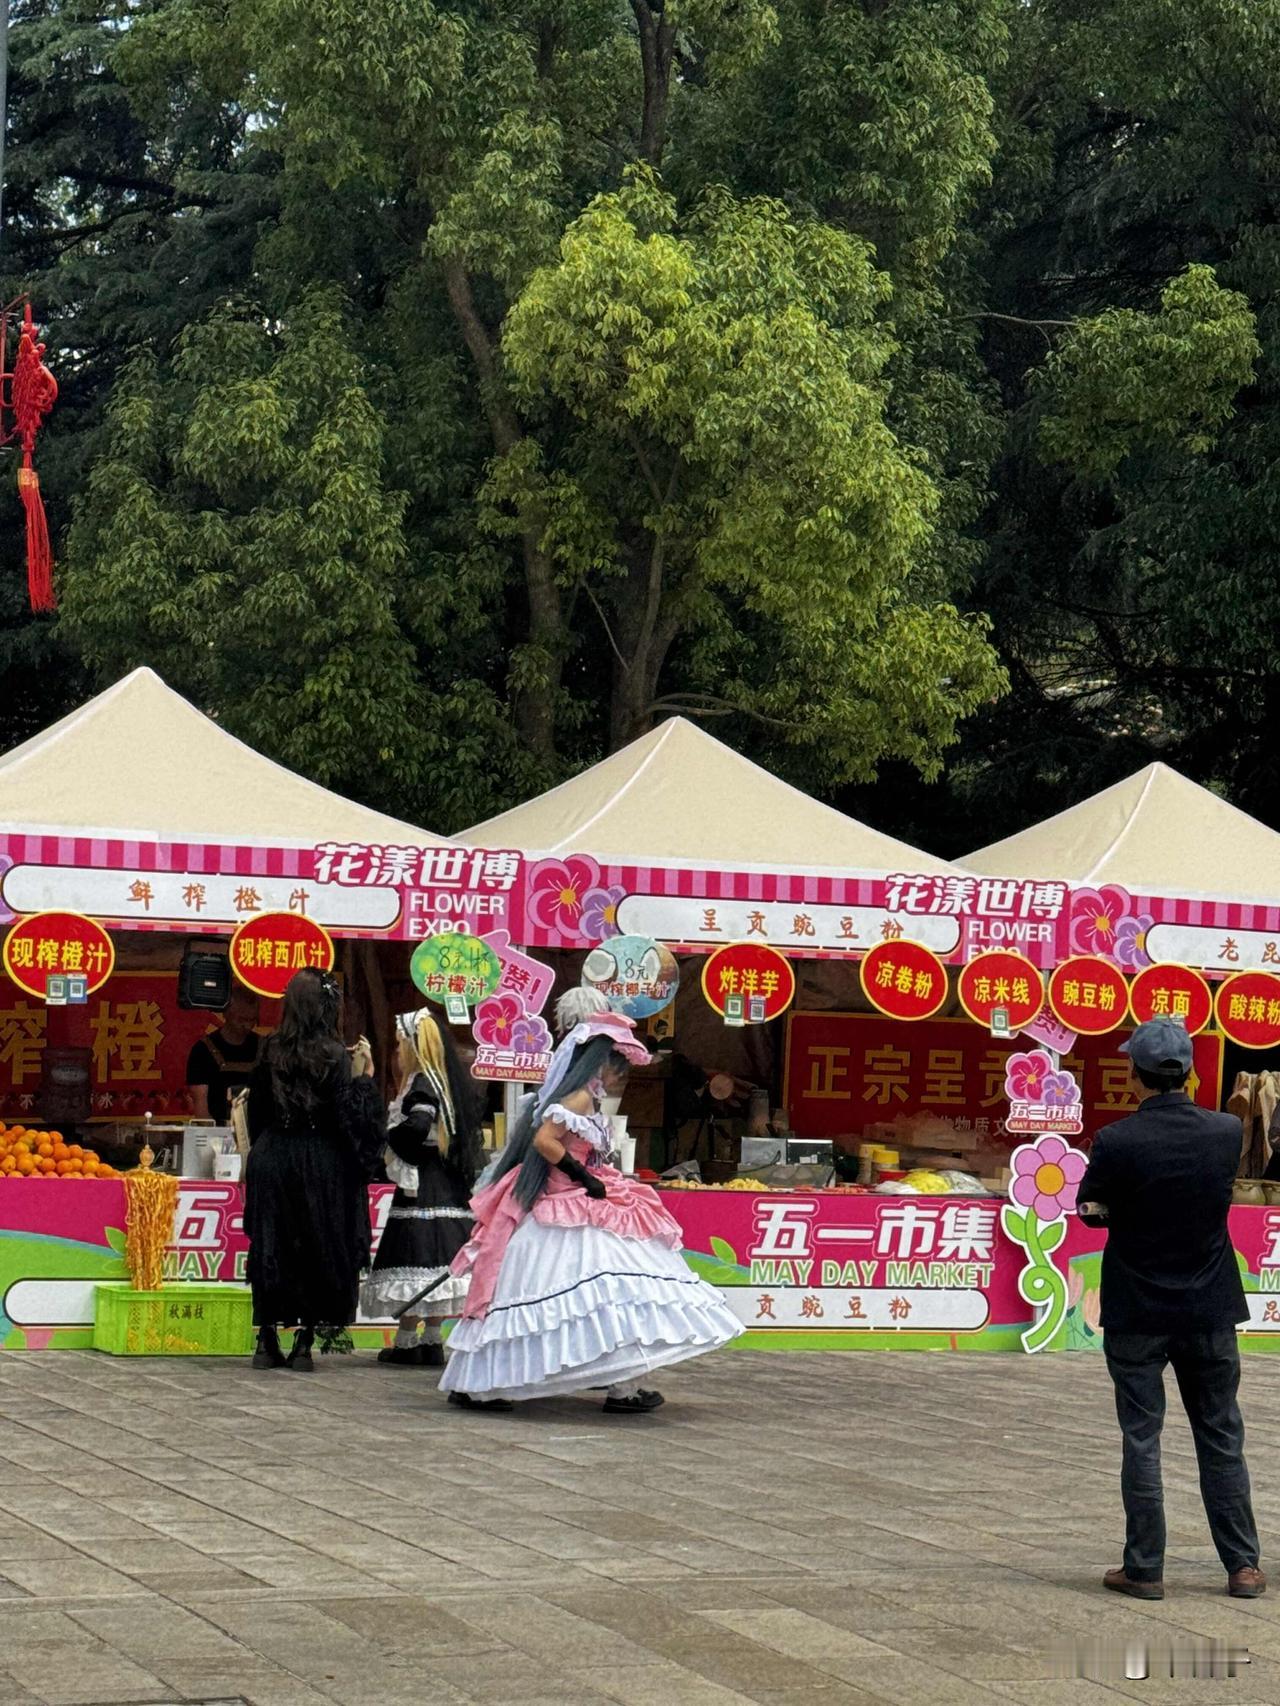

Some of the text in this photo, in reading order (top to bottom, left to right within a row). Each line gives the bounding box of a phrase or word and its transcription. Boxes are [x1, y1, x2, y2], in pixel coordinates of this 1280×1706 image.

[314, 845, 520, 891] 花漾世博
[126, 878, 310, 915] 鲜榨橙汁
[409, 892, 505, 915] FLOWER
[886, 877, 1065, 919] 花漾世博
[699, 907, 905, 940] 呈贡豌豆粉
[968, 920, 1052, 943] FLOWER
[11, 937, 108, 973] 现榨橙汁
[238, 937, 326, 968] 现榨西瓜汁
[624, 958, 649, 980] 8元
[719, 966, 780, 999] 炸洋芋
[875, 960, 933, 1000] 凉卷粉
[426, 972, 488, 997] 柠檬汁
[973, 977, 1031, 1006] 凉米线
[1062, 979, 1117, 1011] 豌豆粉
[1150, 987, 1192, 1017] 凉面
[1228, 993, 1280, 1025] 酸辣粉
[478, 1048, 551, 1067] 五一市集
[475, 1067, 546, 1080] MAY DAY MARKE
[1010, 1120, 1078, 1132] MAY DAY MARKET
[1012, 1102, 1079, 1121] 五一市集
[751, 1203, 999, 1259] 五一市集
[751, 1259, 996, 1289] MAY DAY MARKET
